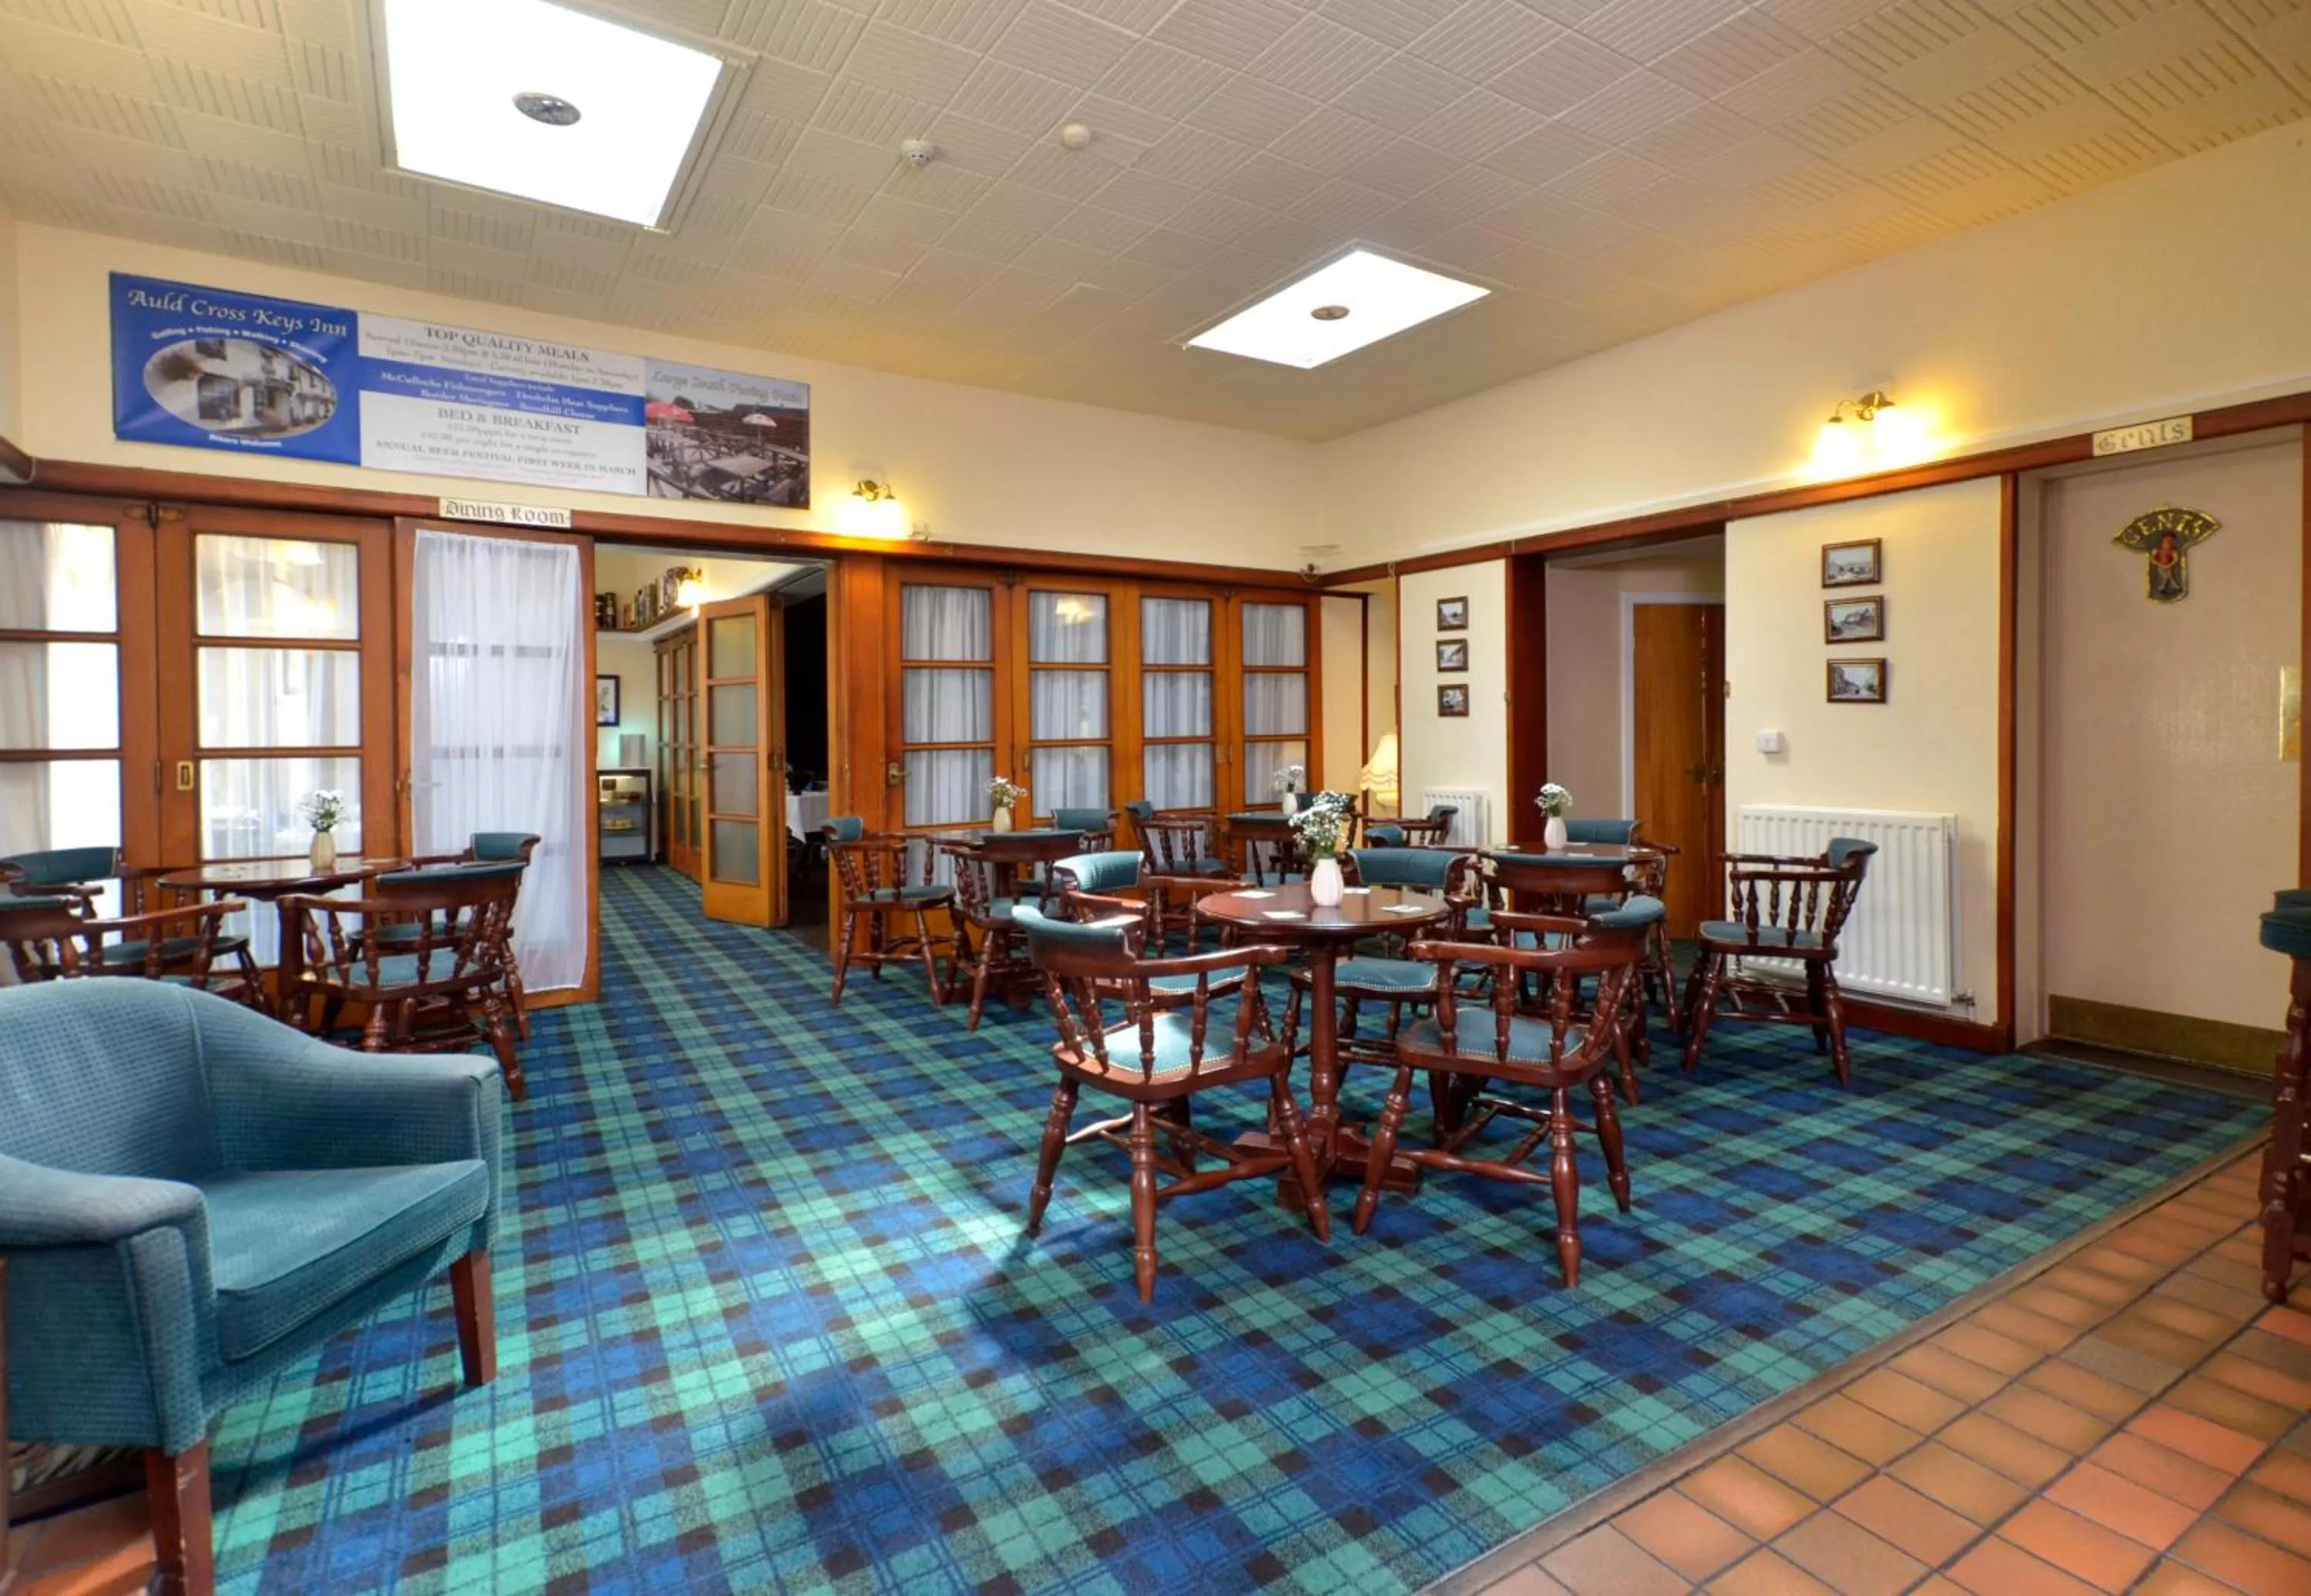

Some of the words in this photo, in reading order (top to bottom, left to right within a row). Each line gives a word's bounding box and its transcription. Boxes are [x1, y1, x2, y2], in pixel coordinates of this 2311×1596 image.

[128, 289, 188, 313] Auld
[191, 299, 246, 321] Cross
[252, 309, 304, 334] Keys
[310, 317, 347, 337] Inn
[424, 327, 459, 341] TOP
[462, 331, 532, 354] QUALITY
[538, 344, 589, 361] MEALS
[438, 407, 472, 422] BED
[477, 412, 487, 424] &
[491, 414, 582, 435] BREAKFAST
[587, 400, 629, 414] Suppliers
[2098, 423, 2185, 452] Gents
[374, 438, 425, 453] ANNUAL
[428, 444, 458, 457] BEER
[462, 448, 512, 462] FESTIVAL
[517, 454, 547, 466] FIRST
[550, 458, 580, 470] WEEK
[582, 461, 595, 471] IN
[599, 463, 636, 475] MARCH
[445, 500, 505, 521] Dining
[509, 506, 565, 524] Room
[2122, 511, 2204, 544] GENTS
